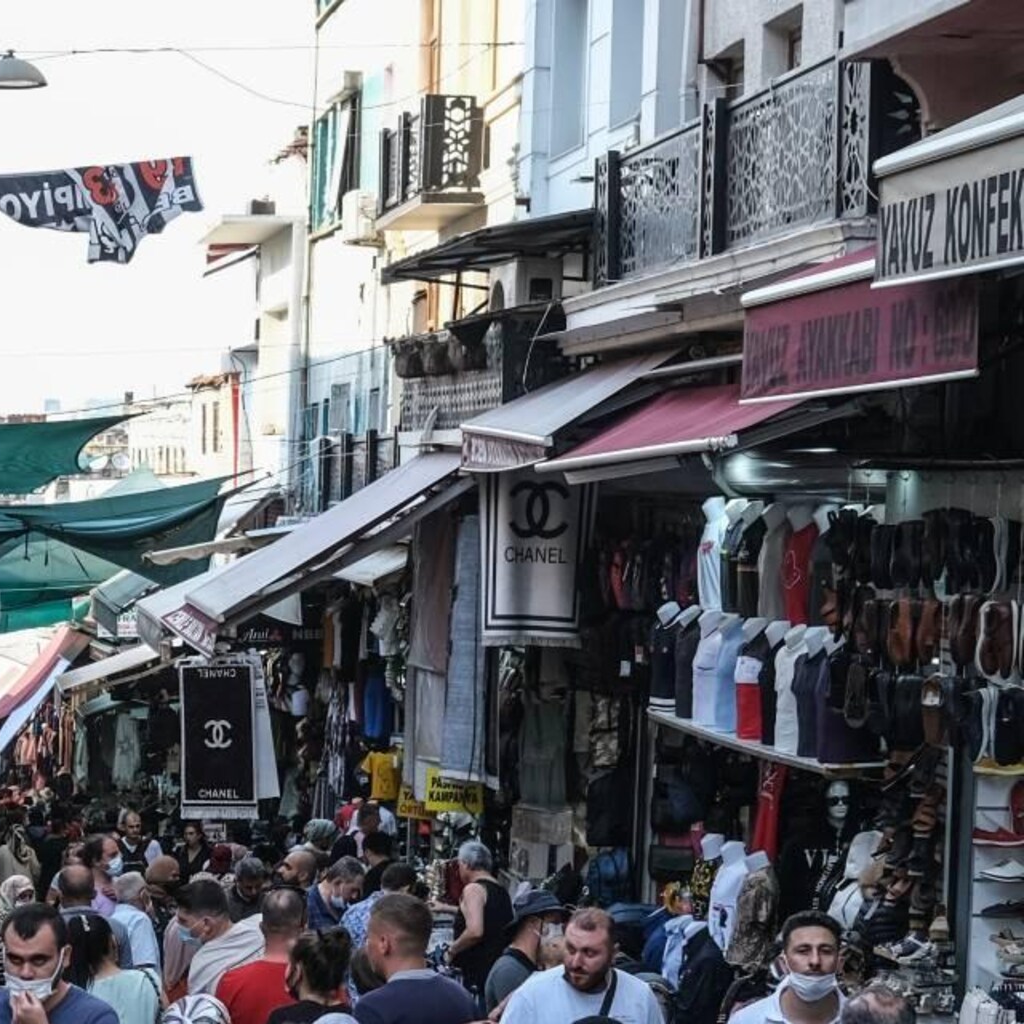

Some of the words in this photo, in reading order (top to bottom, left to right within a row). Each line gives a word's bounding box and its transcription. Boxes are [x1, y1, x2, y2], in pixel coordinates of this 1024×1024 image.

[881, 193, 936, 277] YAVUZ
[796, 308, 881, 381] AYAKKABI
[504, 546, 568, 564] CHANEL
[198, 668, 237, 679] CHANEL
[198, 788, 239, 799] CHANEL
